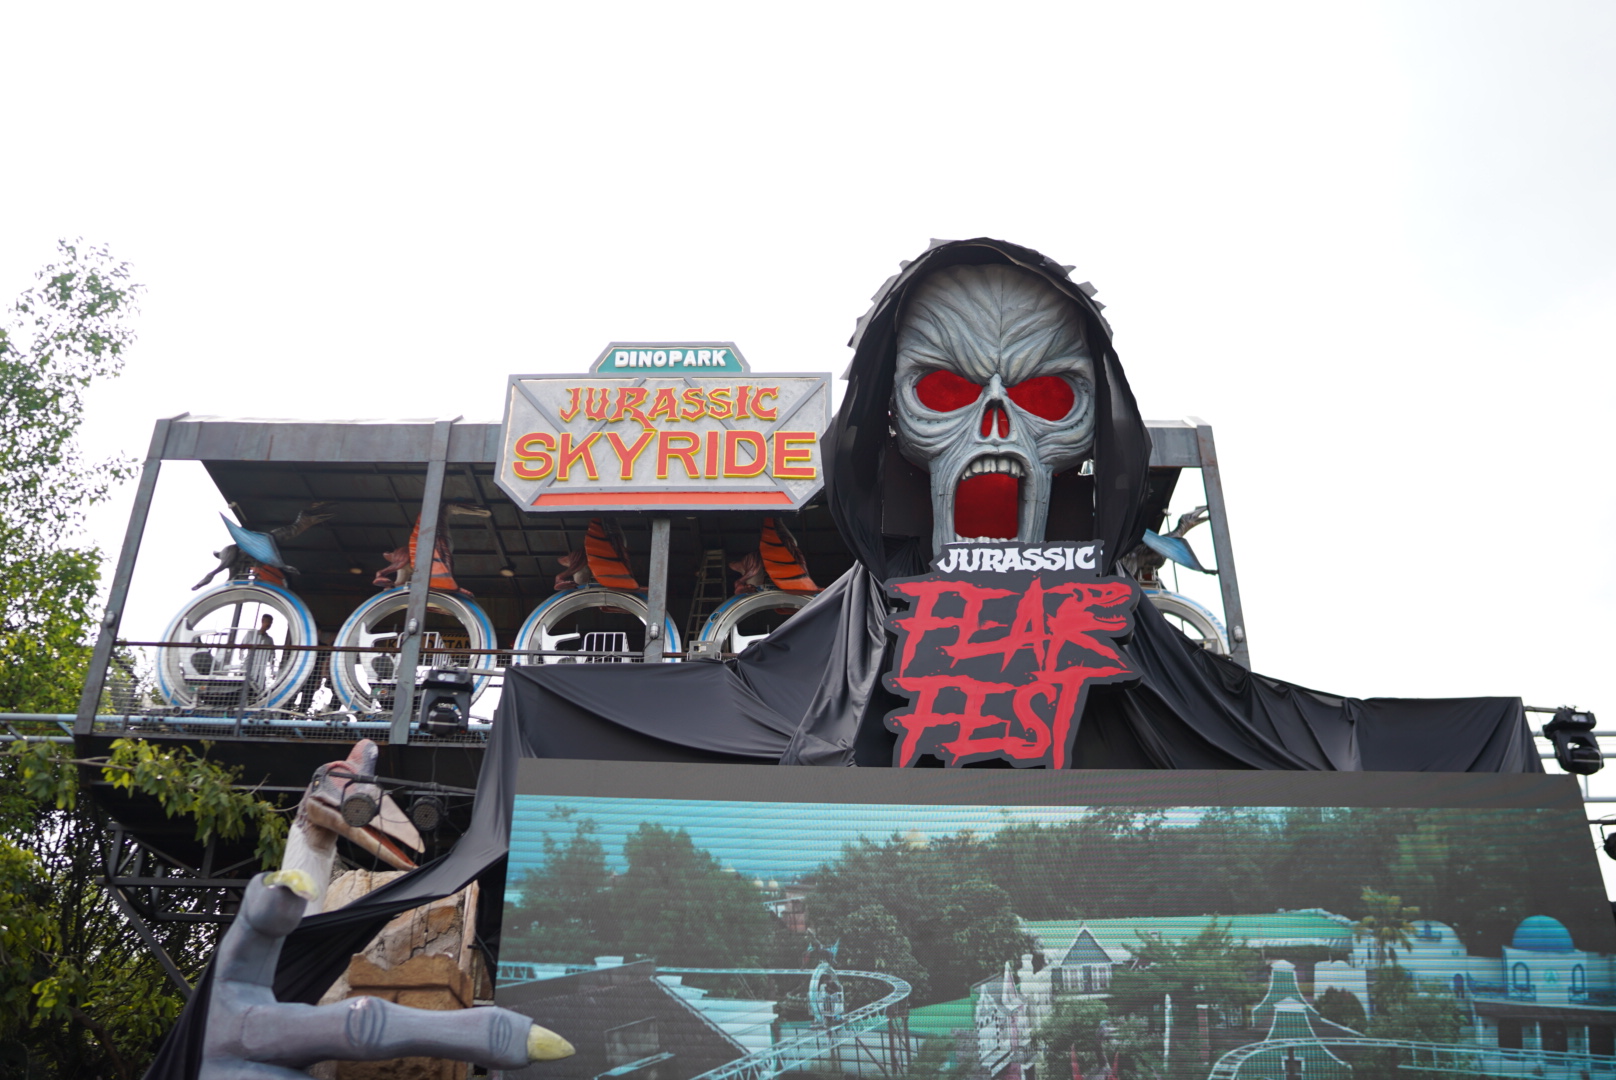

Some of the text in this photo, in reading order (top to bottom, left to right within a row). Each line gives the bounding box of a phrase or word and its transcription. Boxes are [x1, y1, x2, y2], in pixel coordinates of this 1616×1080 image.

[614, 350, 727, 368] DINOPARK
[559, 385, 779, 431] JURASSIC
[512, 430, 817, 481] SKYRIDE
[937, 545, 1096, 573] JURASSIC
[892, 577, 1132, 677] FEAR
[891, 666, 1134, 770] FEST
